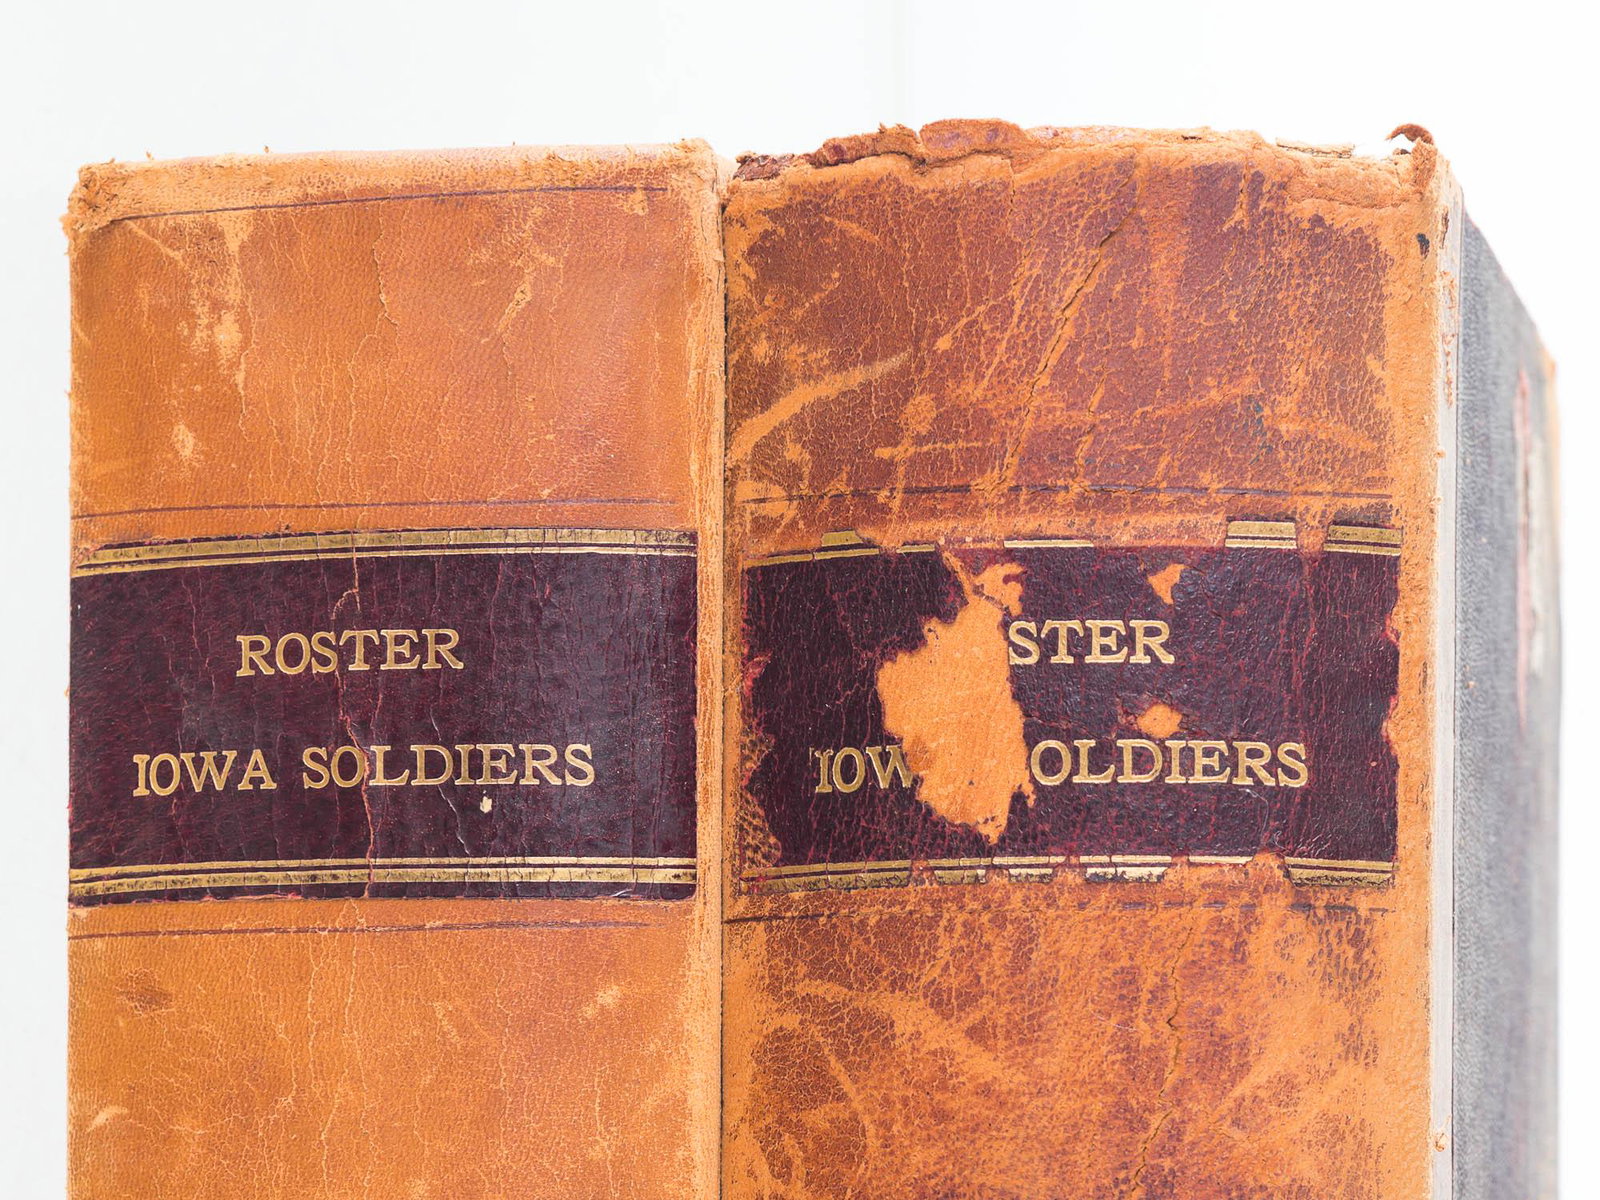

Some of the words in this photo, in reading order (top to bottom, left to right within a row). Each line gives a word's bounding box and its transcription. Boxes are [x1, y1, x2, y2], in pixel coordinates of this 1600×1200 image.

[236, 628, 464, 677] ROSTER
[1008, 619, 1175, 665] STER
[133, 748, 277, 797] IOWA
[302, 743, 595, 789] SOLDIERS
[813, 745, 914, 794] IOW
[1030, 739, 1308, 787] OLDIERS
